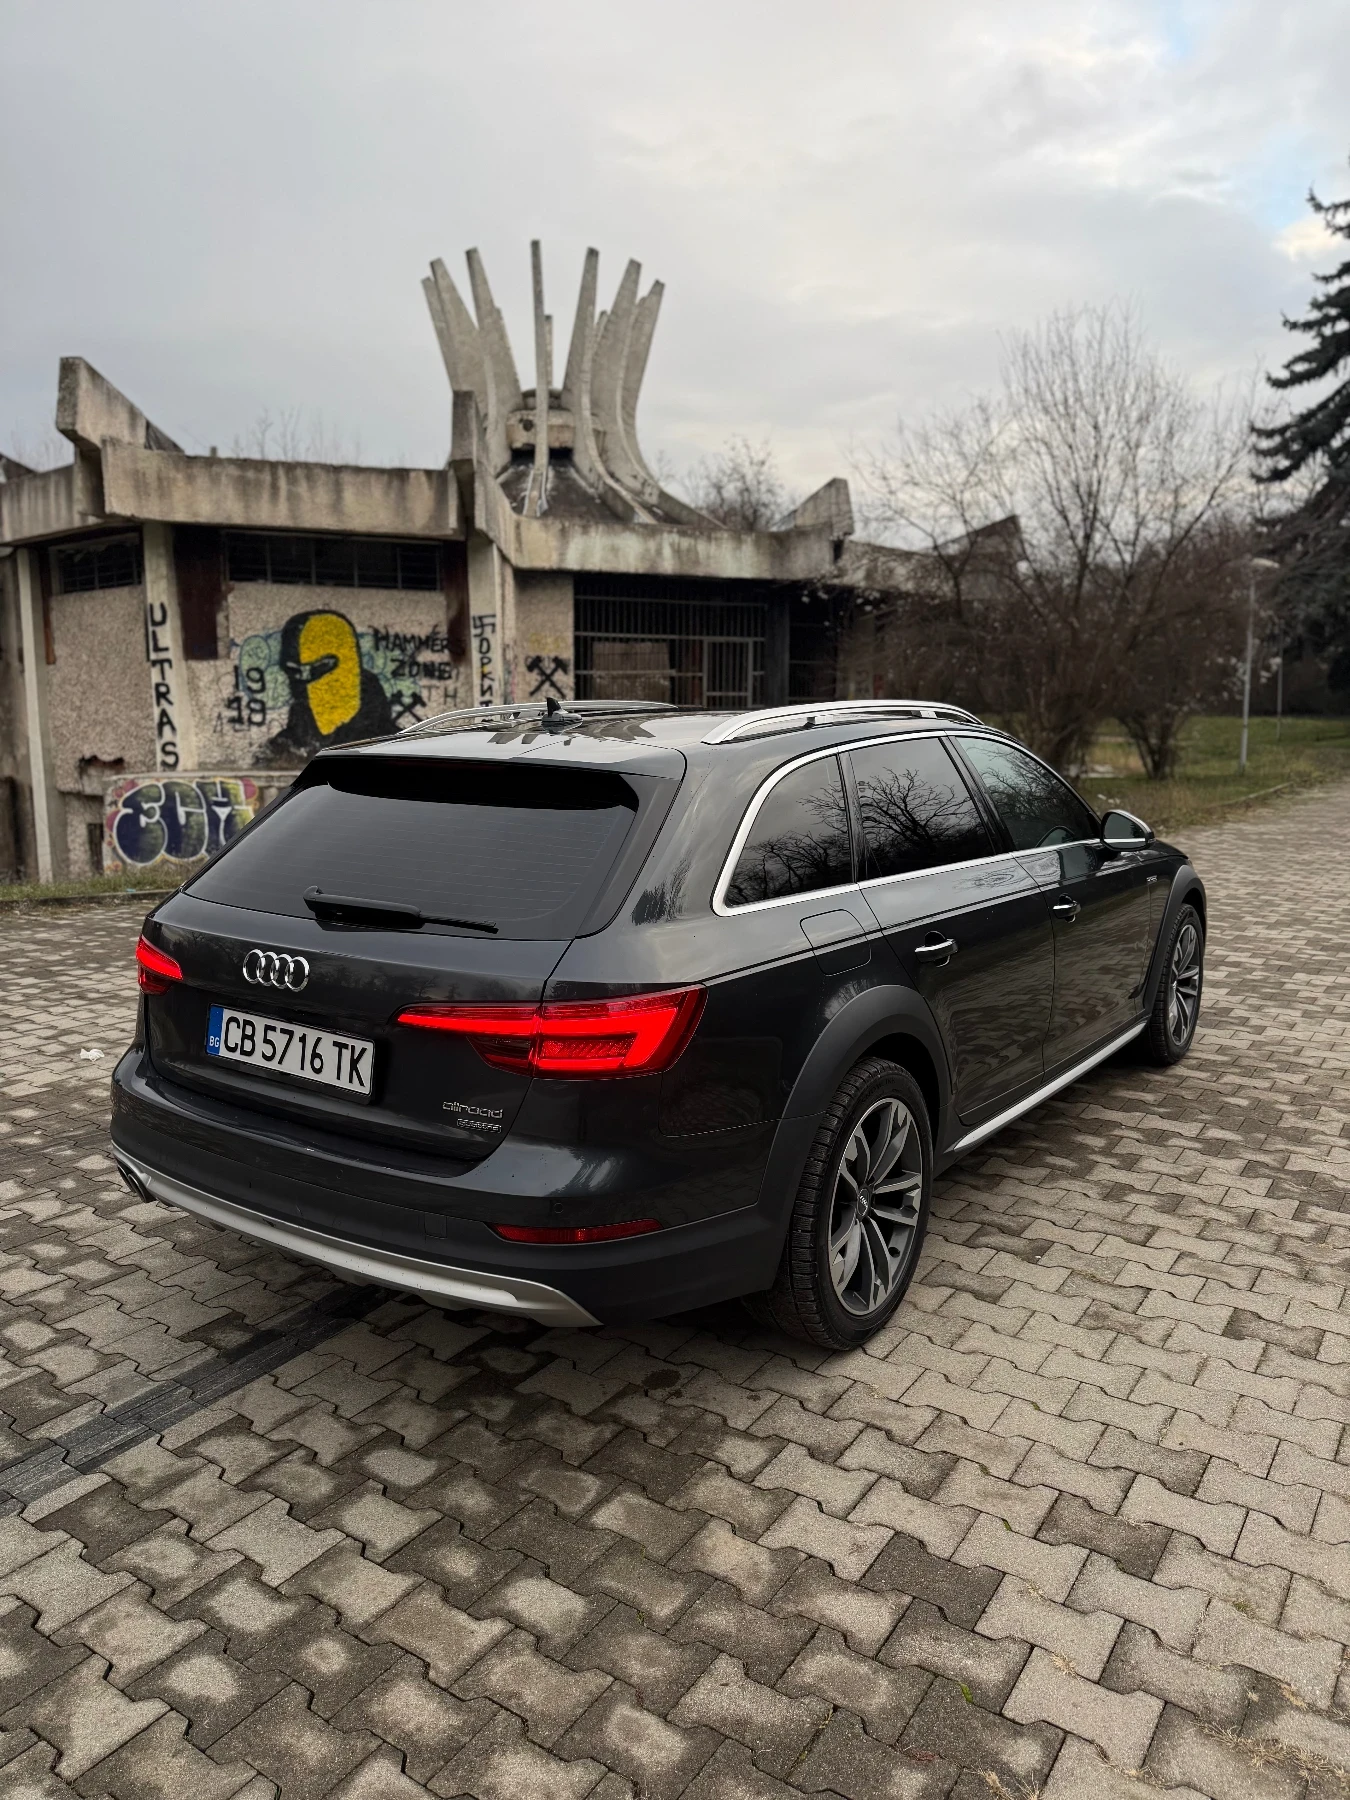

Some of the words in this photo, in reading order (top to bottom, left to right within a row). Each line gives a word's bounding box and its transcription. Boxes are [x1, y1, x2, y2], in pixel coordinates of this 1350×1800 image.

[150, 602, 179, 769] ULTRAS
[209, 1035, 220, 1048] BG
[224, 1016, 256, 1056] CB
[262, 1024, 324, 1074] 5716
[333, 1040, 367, 1087] TK
